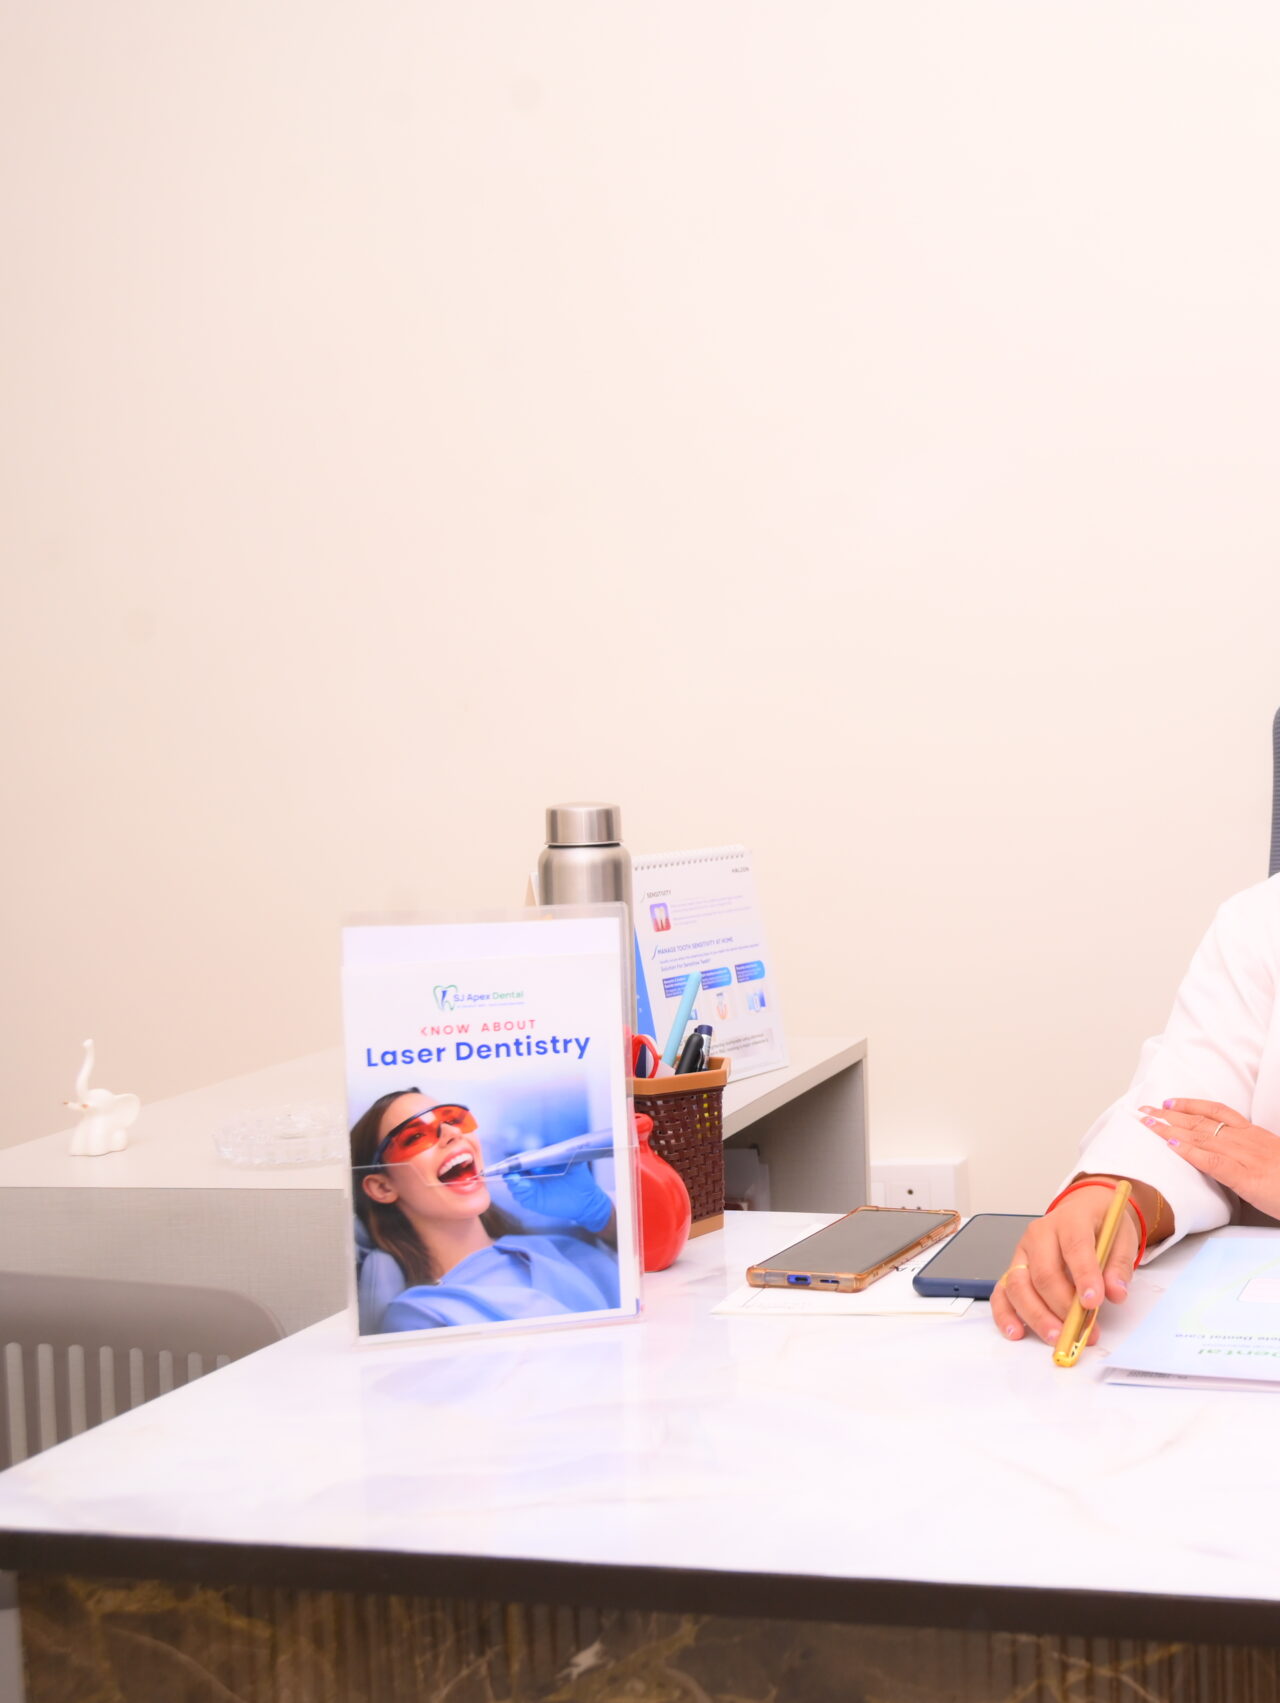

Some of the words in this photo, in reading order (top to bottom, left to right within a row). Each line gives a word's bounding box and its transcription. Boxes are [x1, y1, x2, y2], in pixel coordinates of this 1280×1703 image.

[657, 946, 676, 955] MANAGE
[677, 943, 691, 952] TOOTH
[692, 939, 715, 950] SENSITIVITY
[453, 994, 465, 1002] SJ
[466, 993, 491, 1003] Apex
[492, 990, 524, 1000] Dental
[480, 1019, 537, 1033] ABOUT
[366, 1047, 446, 1067] Laser
[455, 1035, 591, 1060] Dentistry
